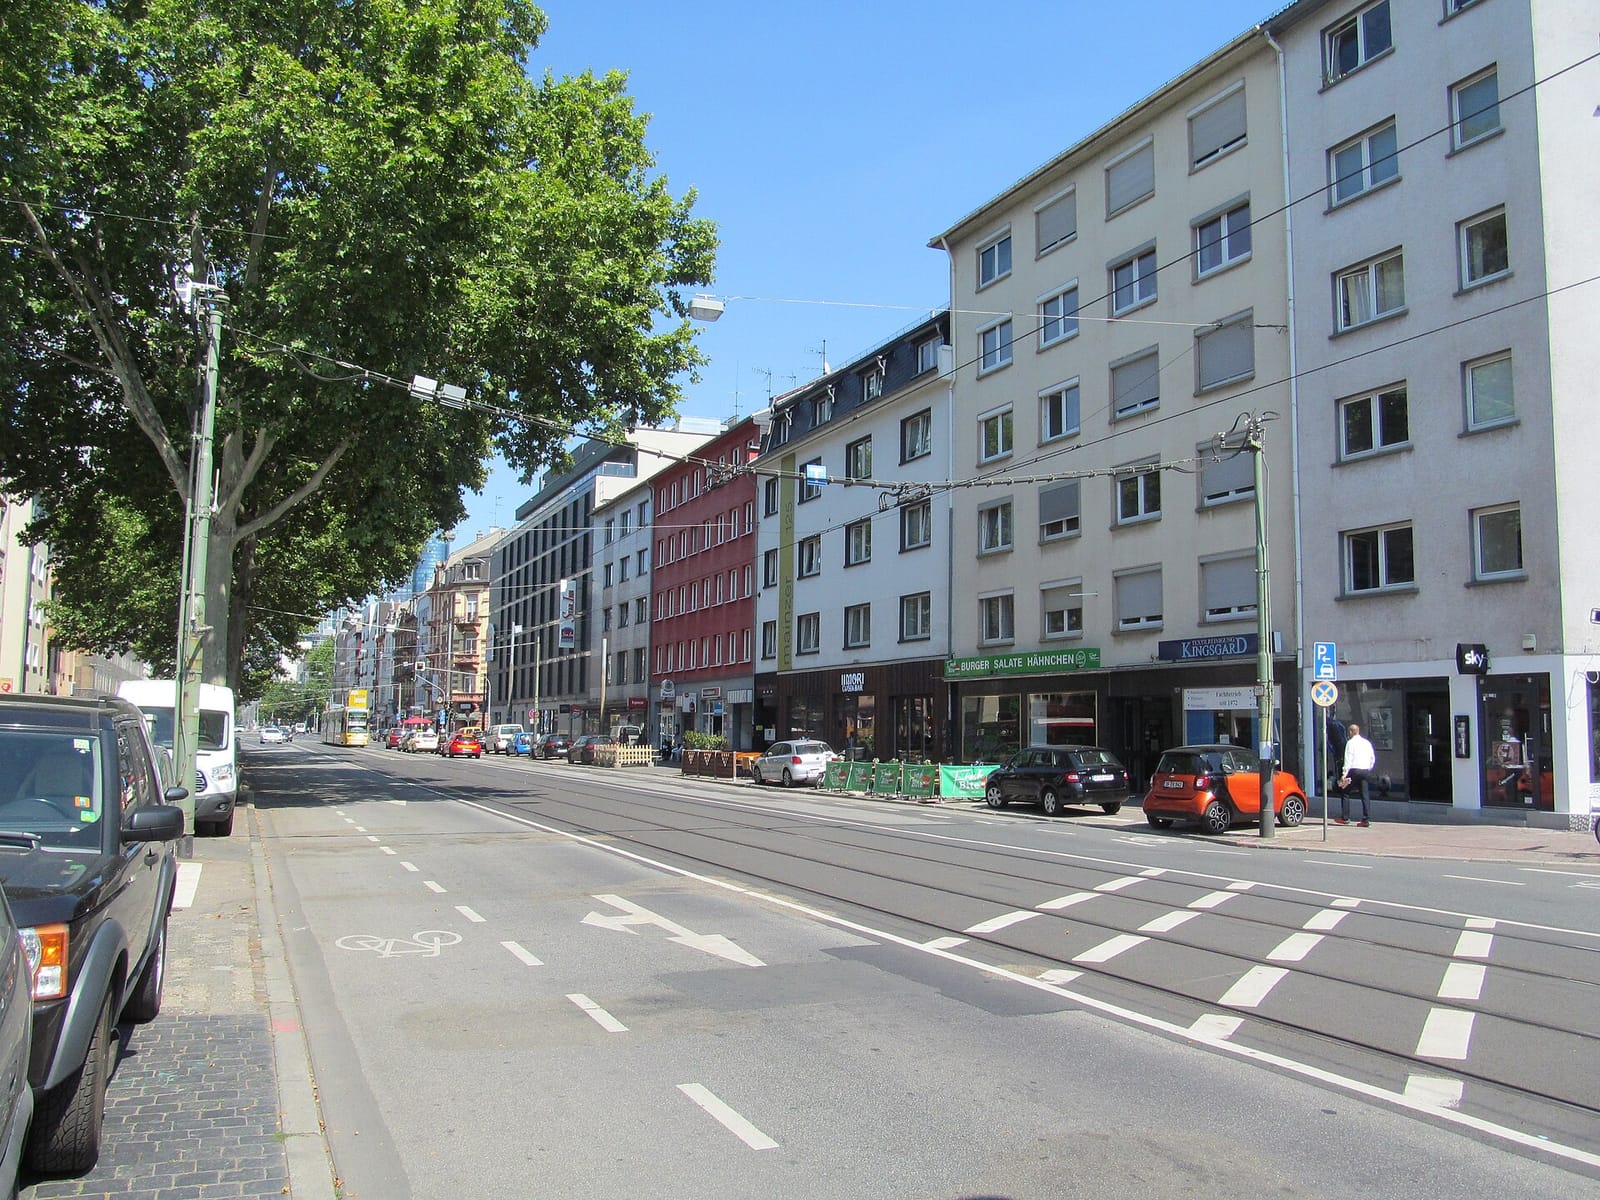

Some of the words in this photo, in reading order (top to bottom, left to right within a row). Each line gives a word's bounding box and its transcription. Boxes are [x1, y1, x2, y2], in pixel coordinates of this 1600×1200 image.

[785, 502, 793, 532] 125
[783, 576, 792, 665] mainzer
[1181, 637, 1248, 658] KINGSGARD
[1317, 645, 1327, 660] P
[961, 660, 990, 672] BURGER
[993, 657, 1023, 669] SALATE
[1027, 654, 1074, 667] HÄHNCHEN
[1464, 650, 1484, 668] sky
[959, 781, 980, 790] Bite
